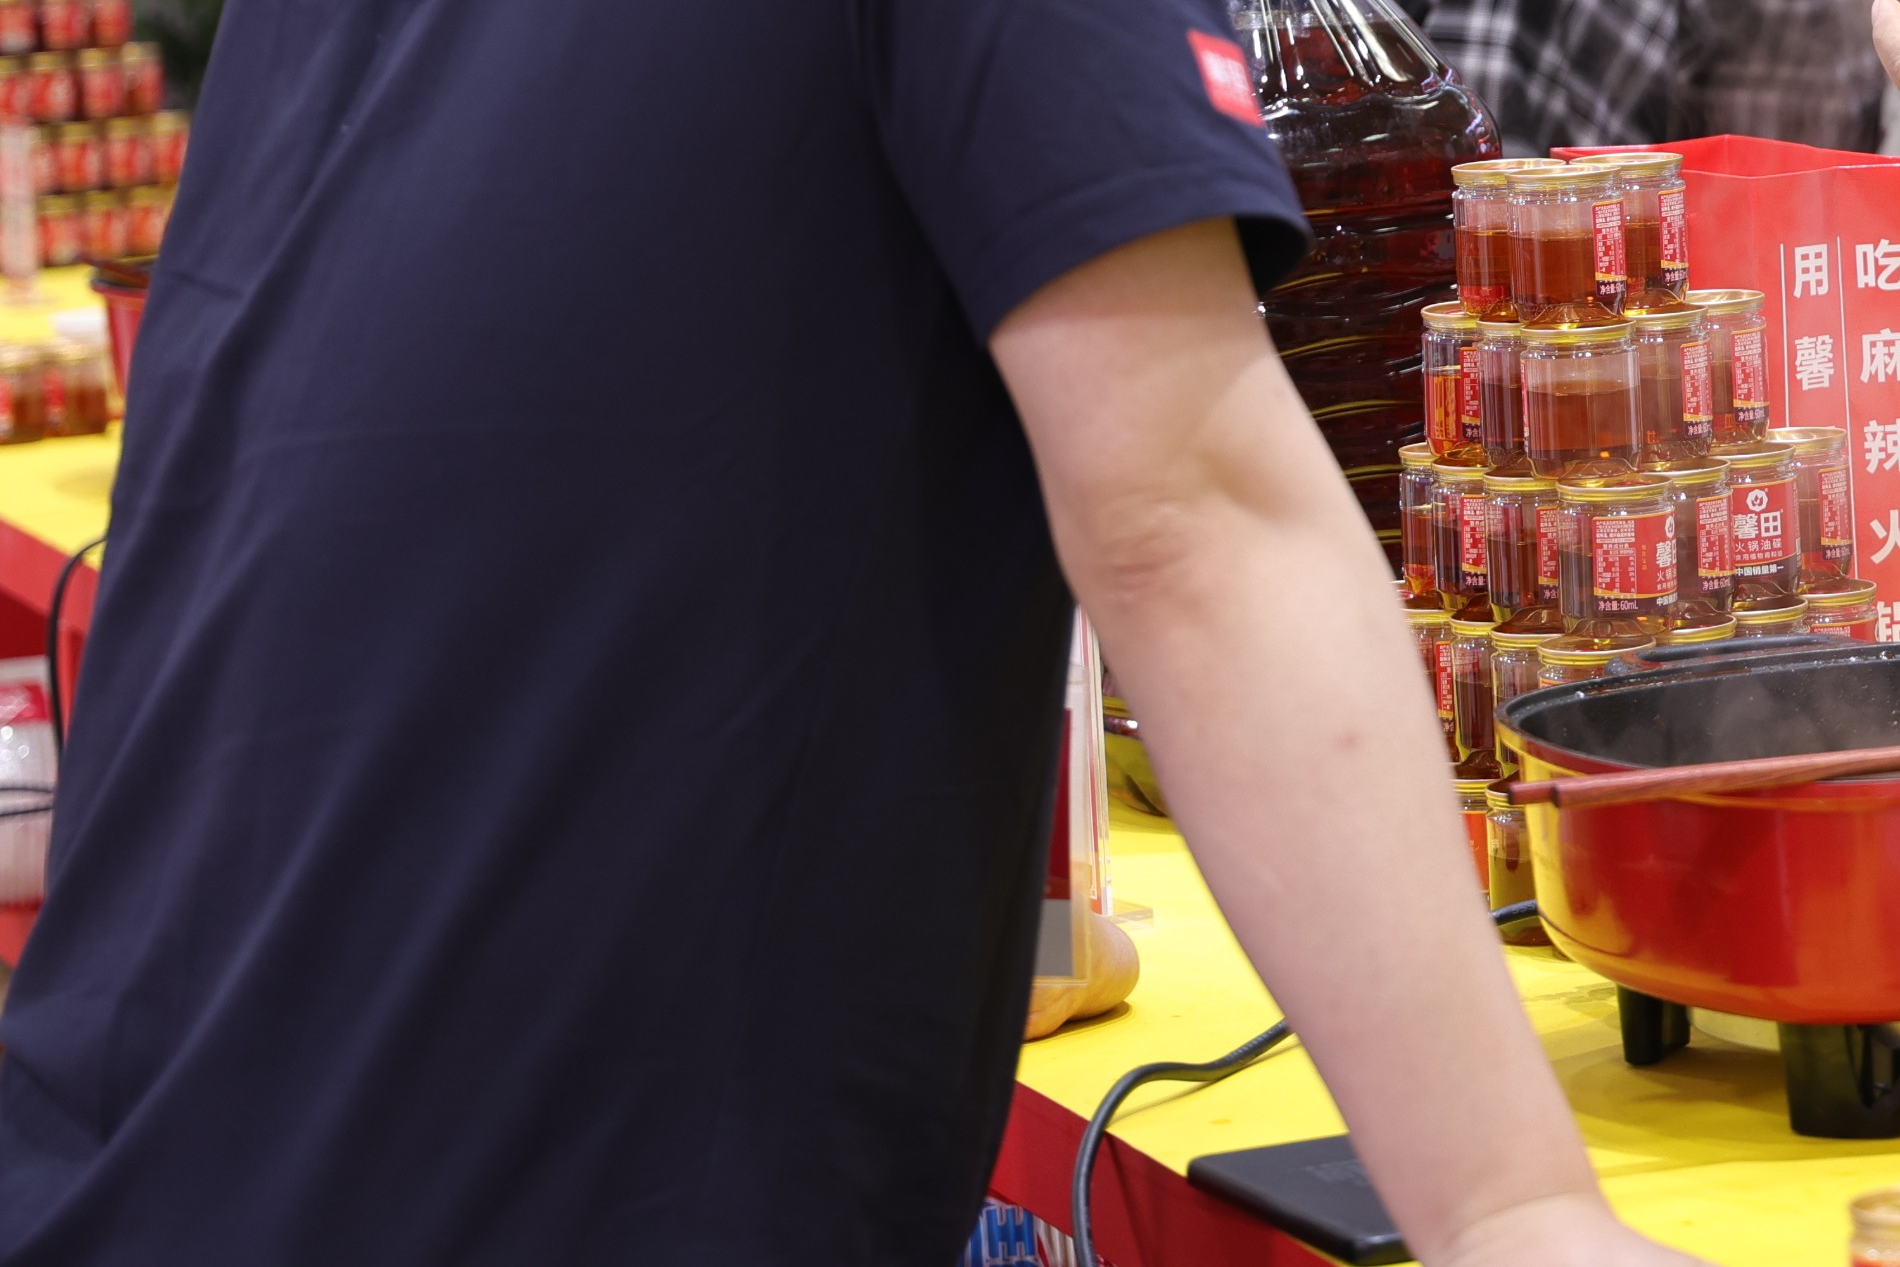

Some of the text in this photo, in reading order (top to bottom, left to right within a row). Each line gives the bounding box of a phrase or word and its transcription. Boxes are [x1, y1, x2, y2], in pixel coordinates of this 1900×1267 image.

[1793, 242, 1835, 391] 用馨
[1733, 511, 1782, 539] 馨田
[1735, 538, 1782, 552] 火锅油碟
[1736, 563, 1784, 577] 中国销量第一
[1598, 600, 1639, 611] 净含量:60mL
